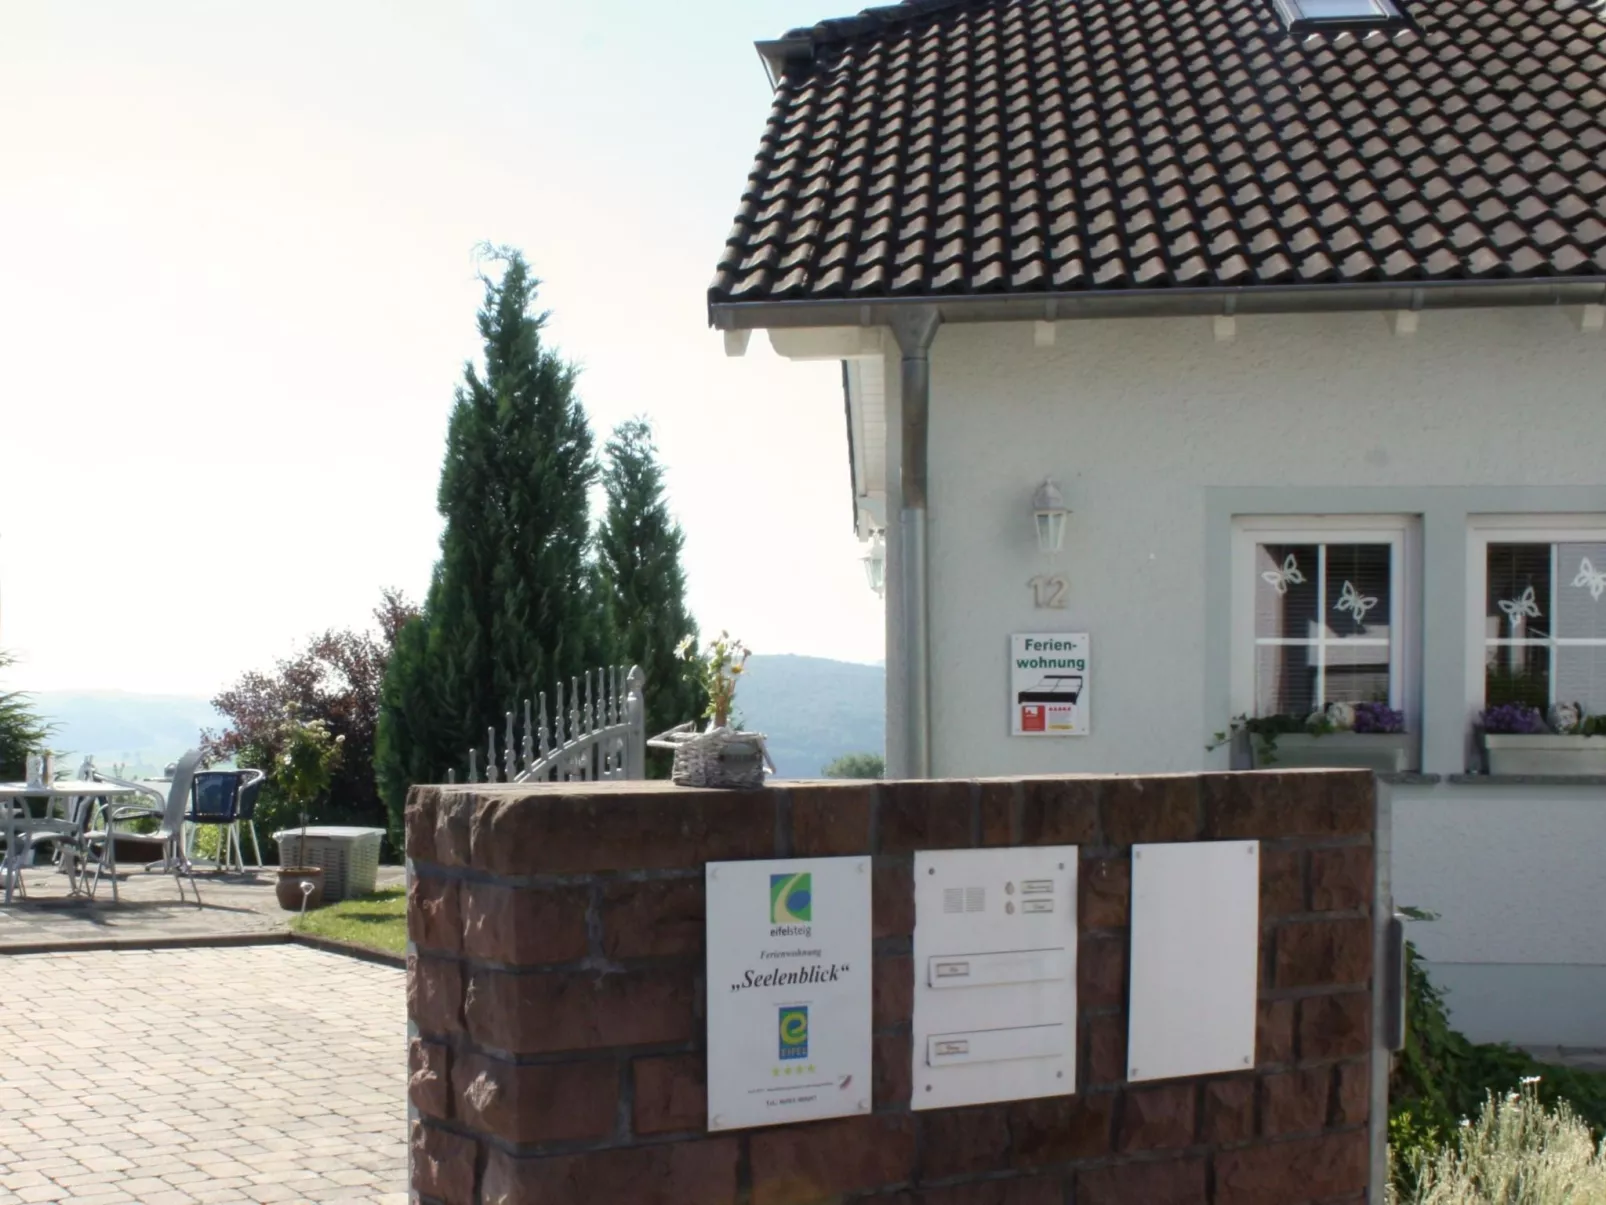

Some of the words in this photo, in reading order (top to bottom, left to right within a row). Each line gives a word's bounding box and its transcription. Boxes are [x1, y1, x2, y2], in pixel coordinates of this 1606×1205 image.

[1026, 576, 1069, 610] 12
[1025, 638, 1077, 651] Ferien-
[1016, 656, 1085, 671] wohnung
[770, 925, 812, 938] eifelsteig
[760, 947, 822, 960] Ferienwohnung
